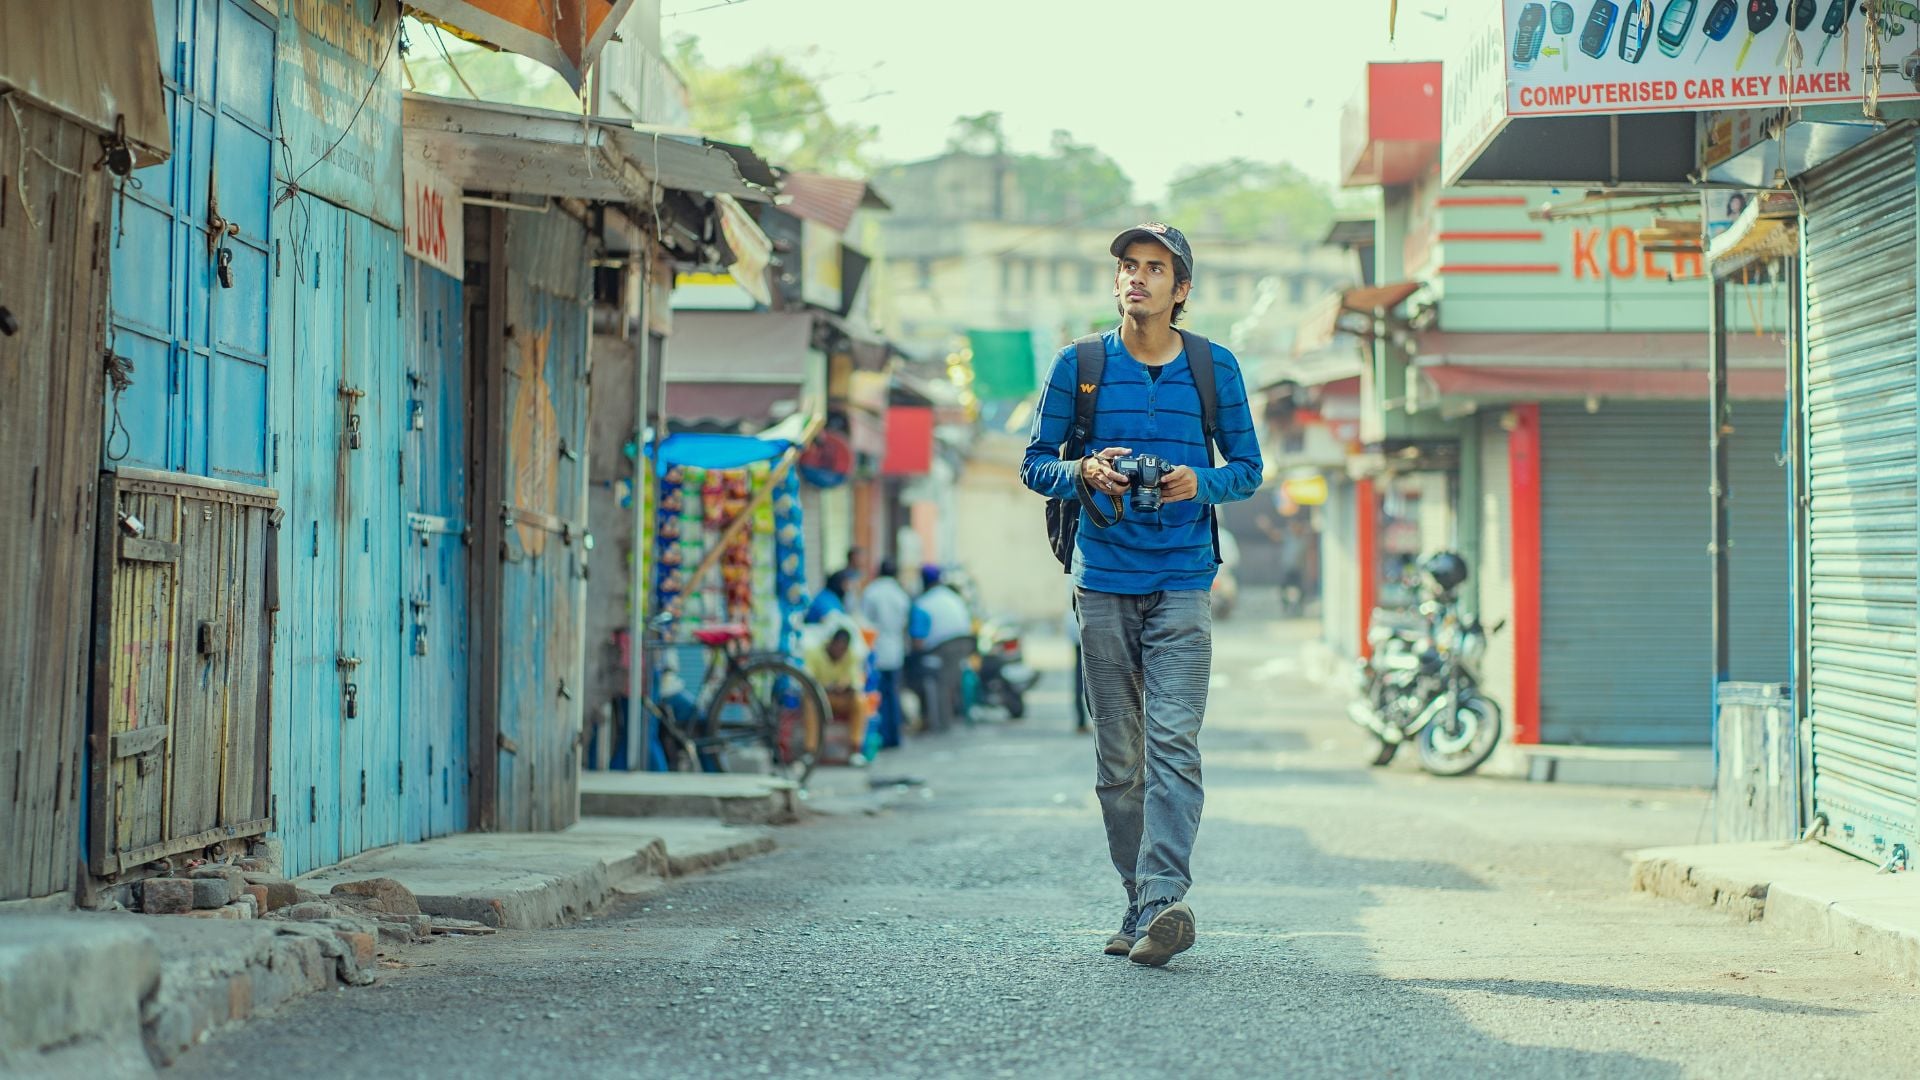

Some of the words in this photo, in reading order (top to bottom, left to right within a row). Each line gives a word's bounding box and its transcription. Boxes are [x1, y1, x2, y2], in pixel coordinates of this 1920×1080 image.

[1520, 80, 1677, 107] COMPUTERISED
[1684, 79, 1726, 99] CAR
[1732, 76, 1772, 97] KEY
[1779, 72, 1851, 94] MAKER
[415, 180, 447, 264] LOCK
